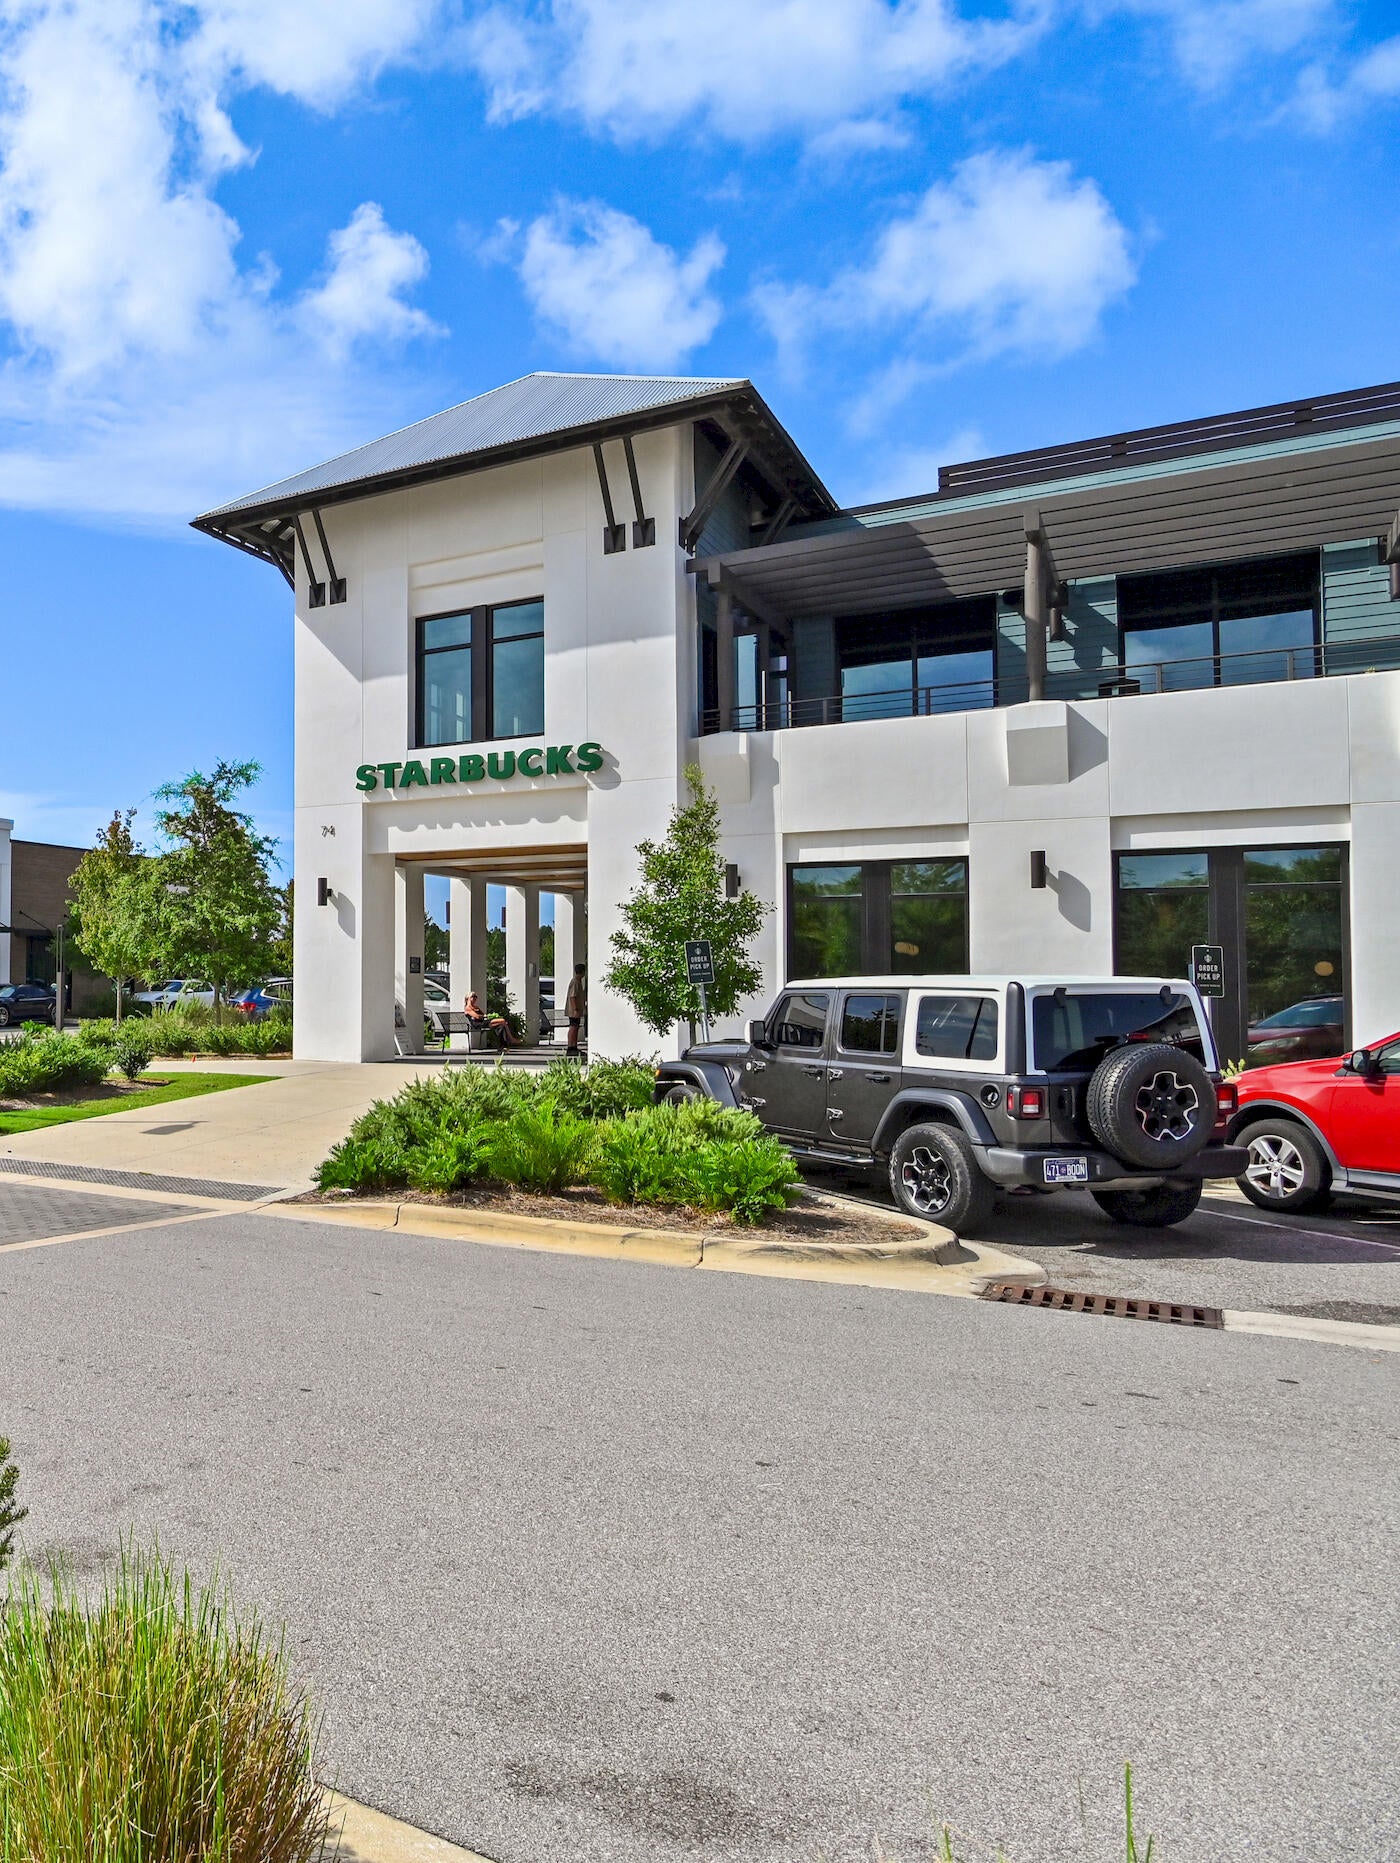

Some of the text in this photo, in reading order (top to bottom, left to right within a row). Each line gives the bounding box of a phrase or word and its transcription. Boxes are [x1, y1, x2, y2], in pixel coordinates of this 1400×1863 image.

[356, 742, 604, 791] STARBUCKS
[1198, 964, 1219, 972] ORDER
[1196, 972, 1221, 981] PICK UP
[1046, 1164, 1061, 1177] 471
